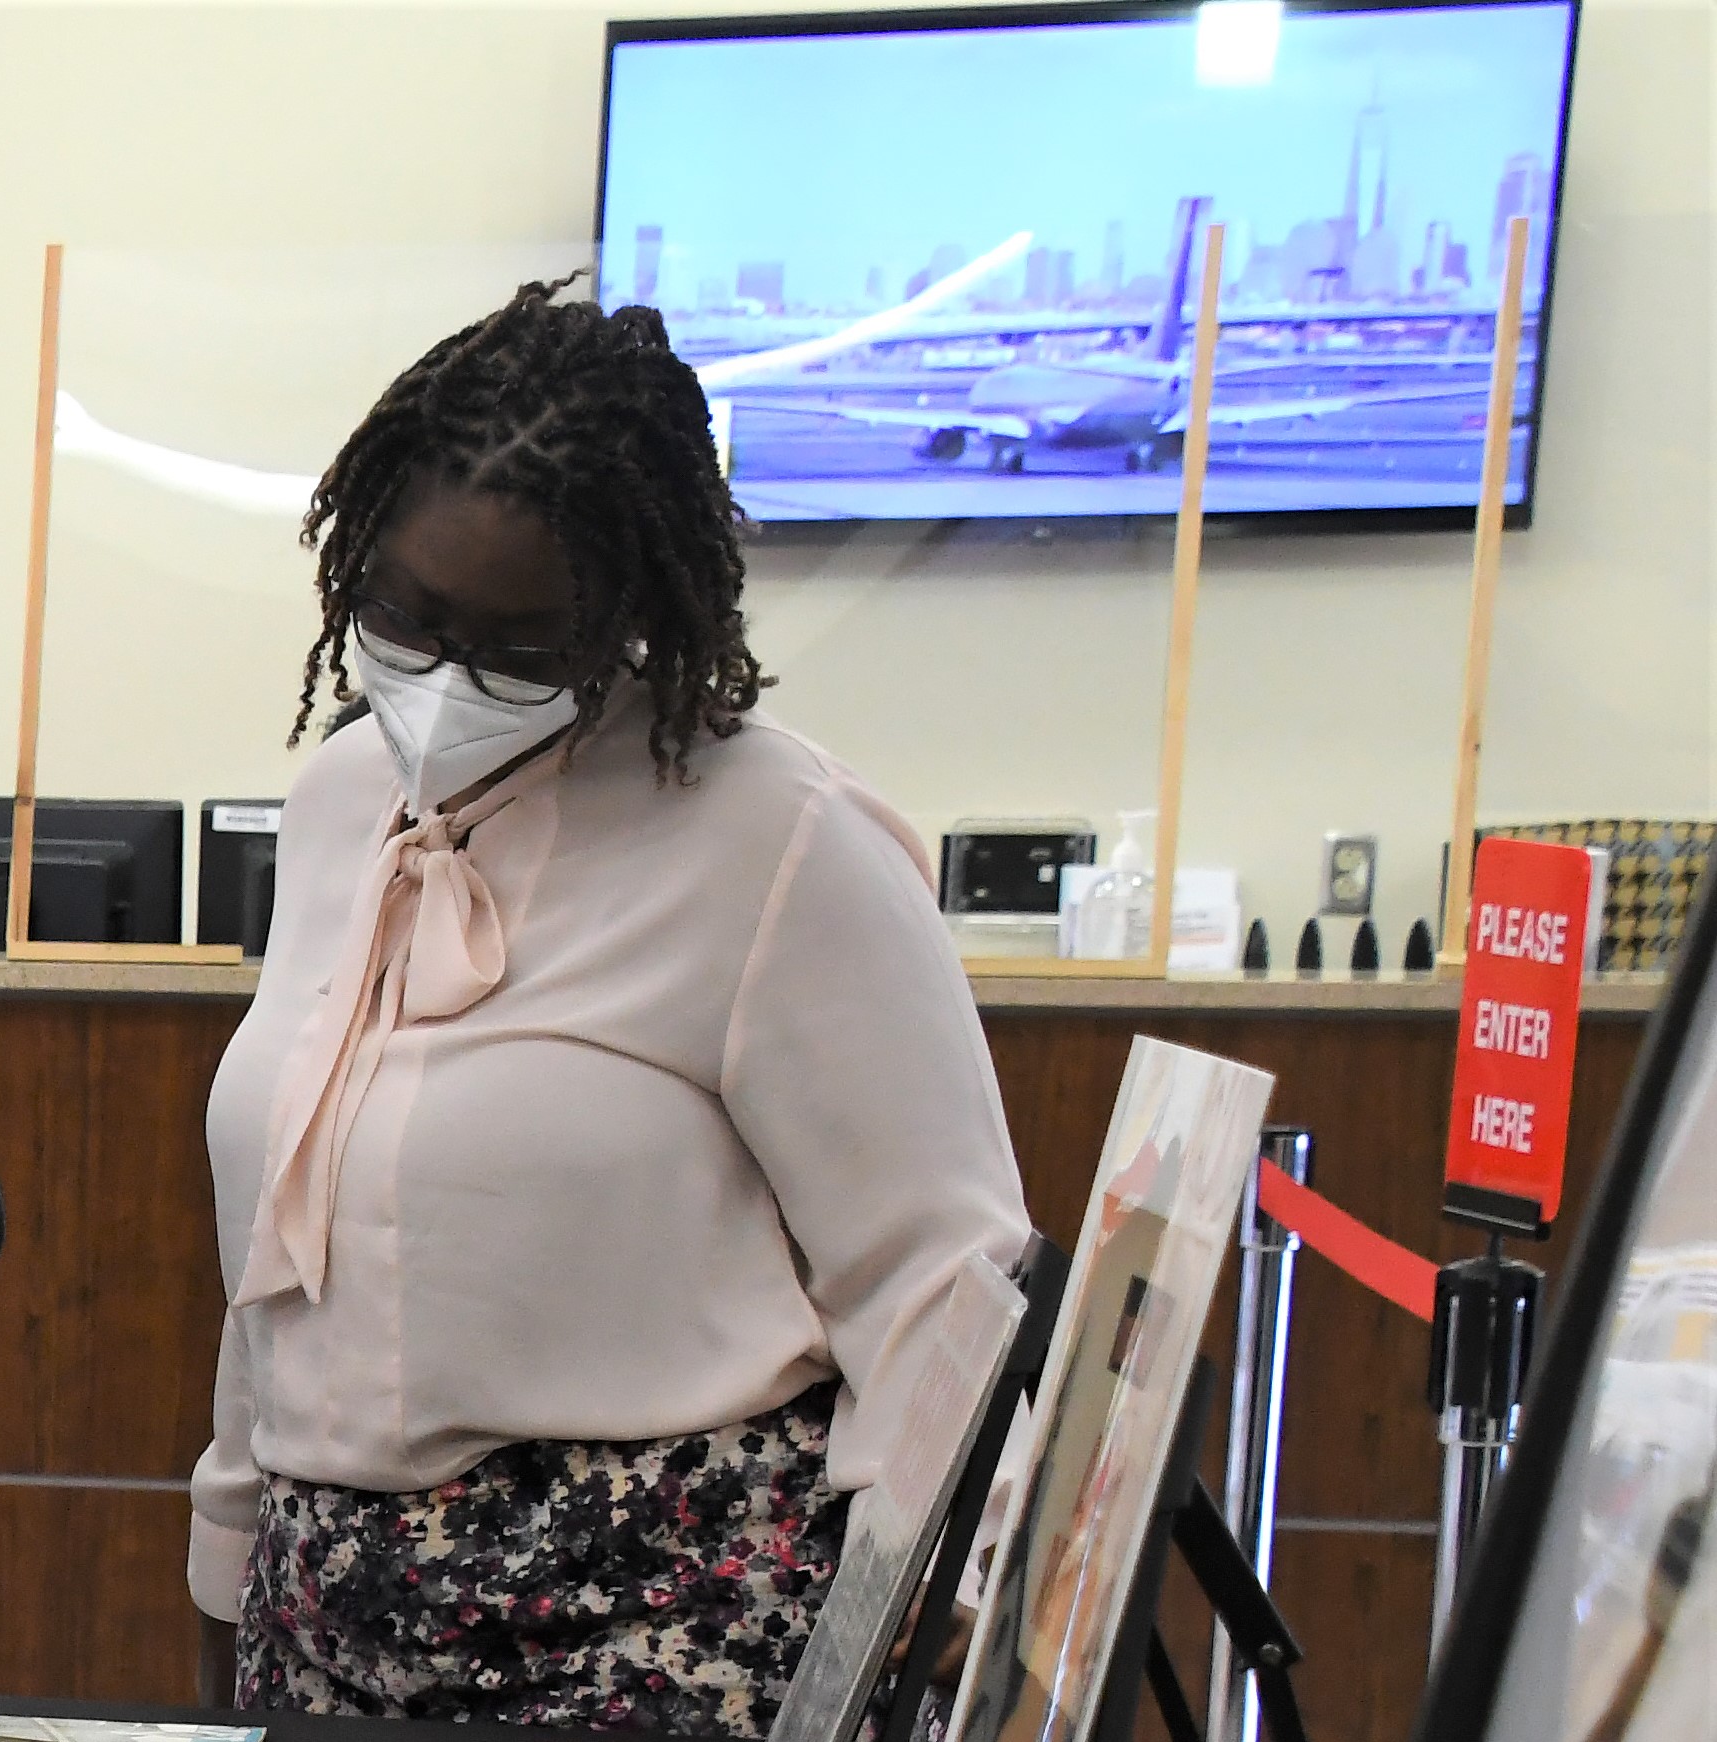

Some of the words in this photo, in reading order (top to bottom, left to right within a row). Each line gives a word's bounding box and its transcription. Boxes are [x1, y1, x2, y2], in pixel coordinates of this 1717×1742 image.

[1476, 903, 1568, 966] PLEASE
[1473, 998, 1551, 1060] ENTER
[1470, 1094, 1536, 1154] HERE
